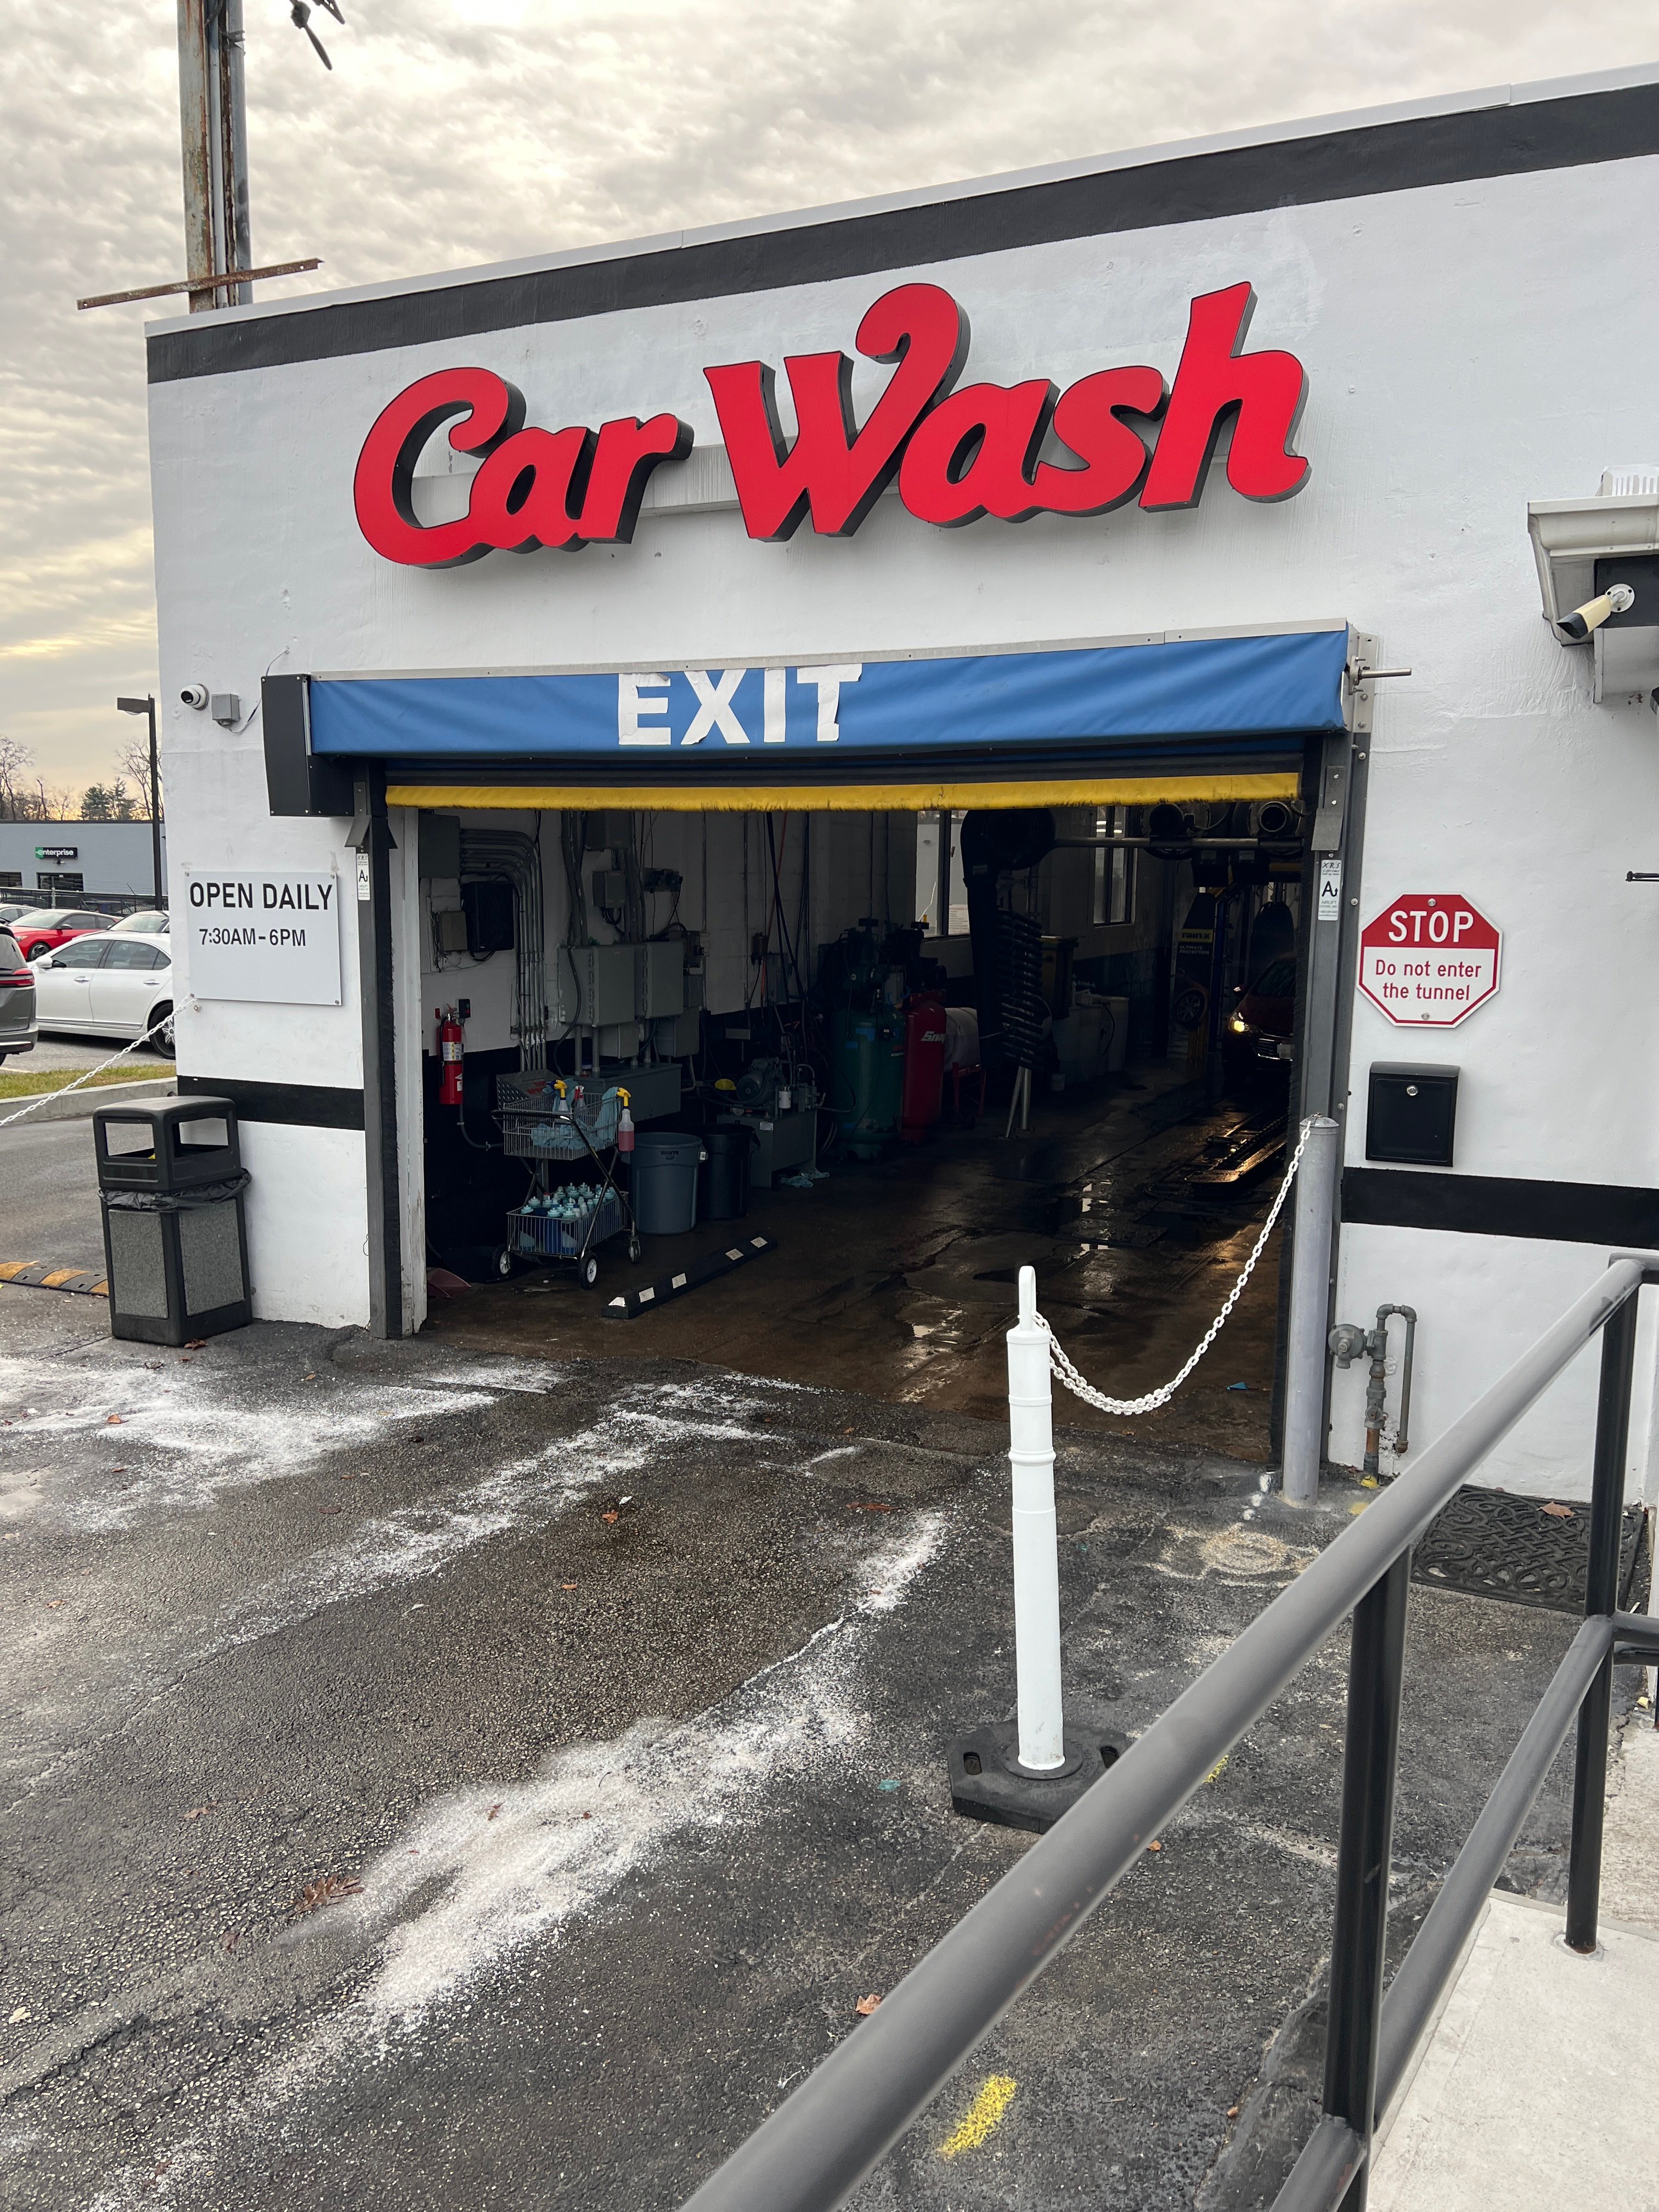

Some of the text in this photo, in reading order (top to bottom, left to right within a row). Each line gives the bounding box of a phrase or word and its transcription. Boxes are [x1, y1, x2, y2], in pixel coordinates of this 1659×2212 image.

[354, 281, 1310, 567] Car Wash
[618, 663, 862, 745] EXIT
[36, 849, 74, 857] enterprise
[190, 882, 332, 910] OPEN DAILY
[1389, 910, 1474, 943] STOP
[1375, 960, 1481, 977] Do not enter
[1383, 983, 1470, 1000] the tunnel
